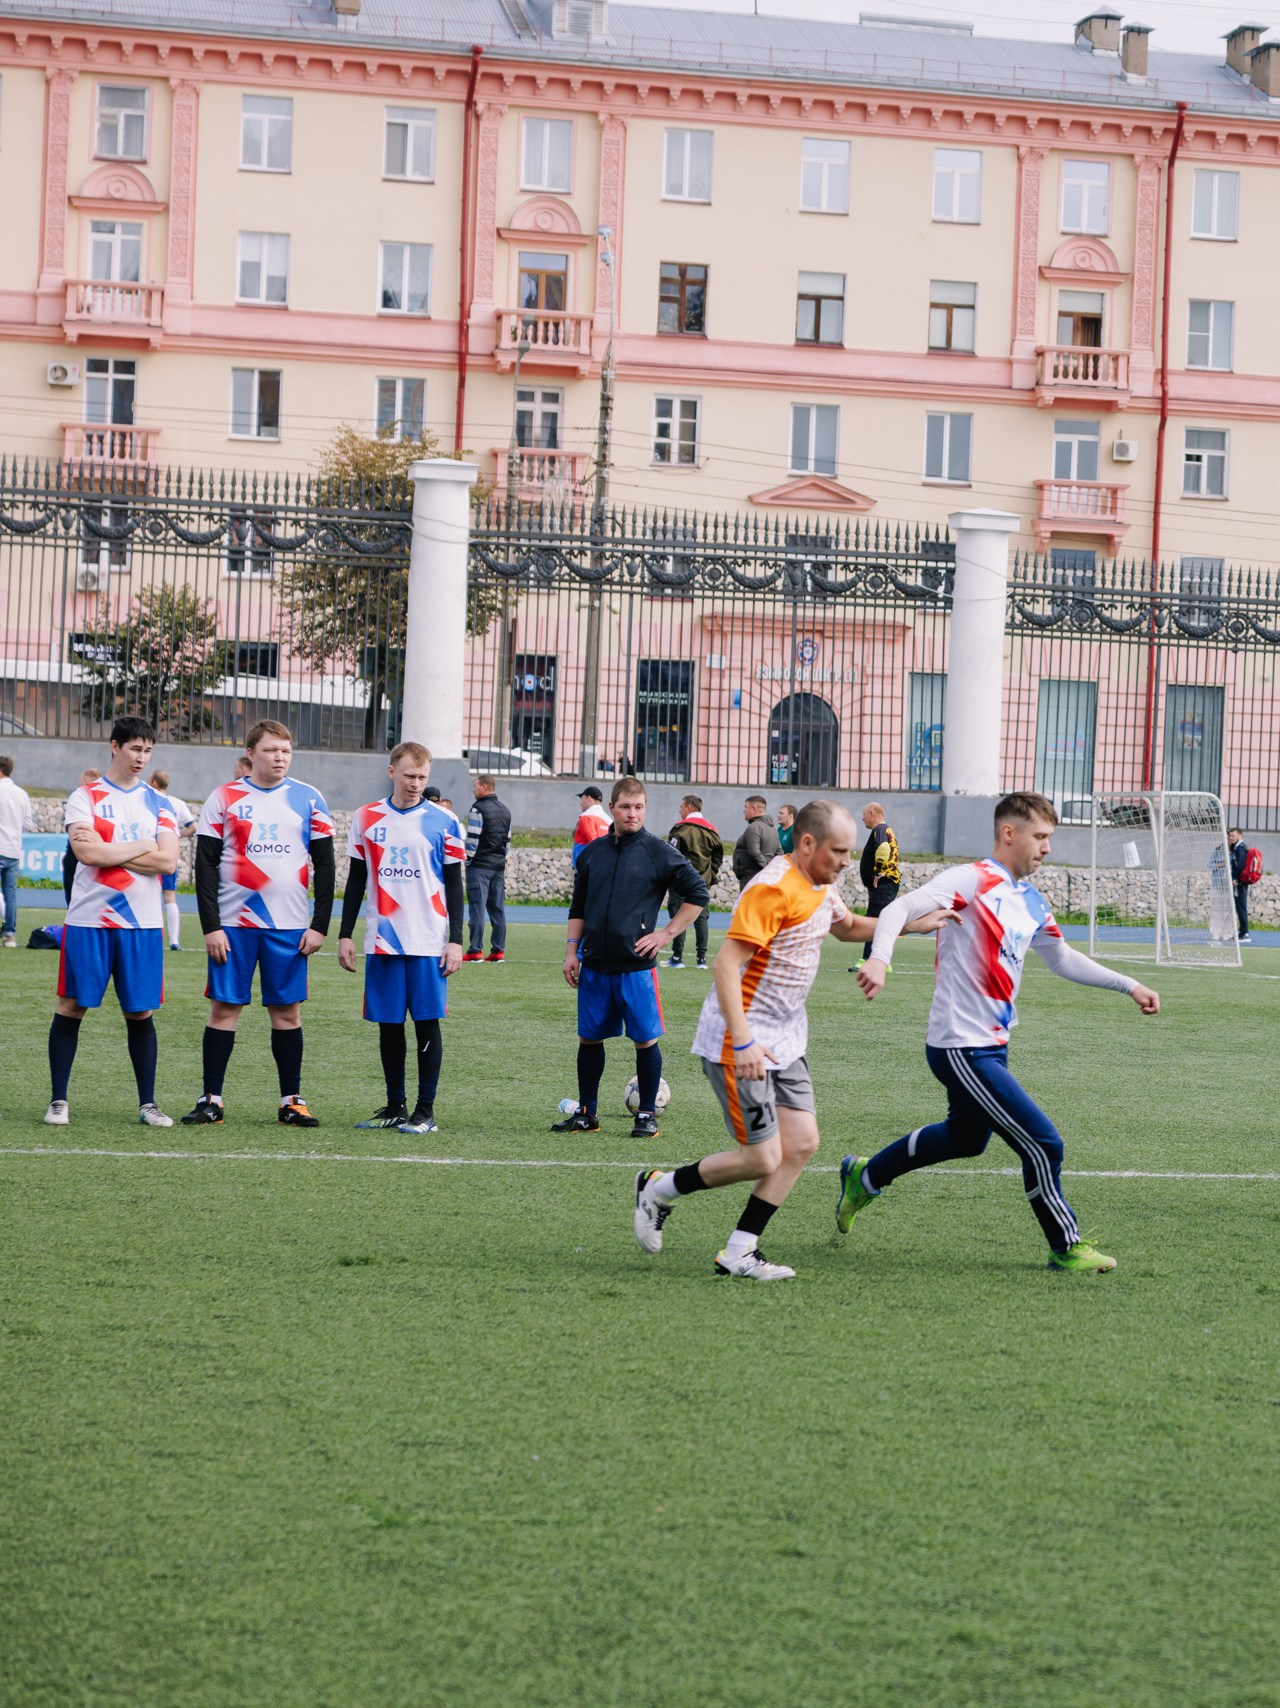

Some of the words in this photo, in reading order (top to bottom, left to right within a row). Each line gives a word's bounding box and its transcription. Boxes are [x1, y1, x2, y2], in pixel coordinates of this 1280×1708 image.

[756, 664, 811, 681] ЯЗЫКООЙ
[101, 804, 114, 819] 11
[238, 805, 253, 820] 12
[373, 827, 386, 843] 13
[246, 844, 290, 853] КОМОС
[378, 867, 421, 878] КОМОС
[747, 1101, 775, 1131] 21
